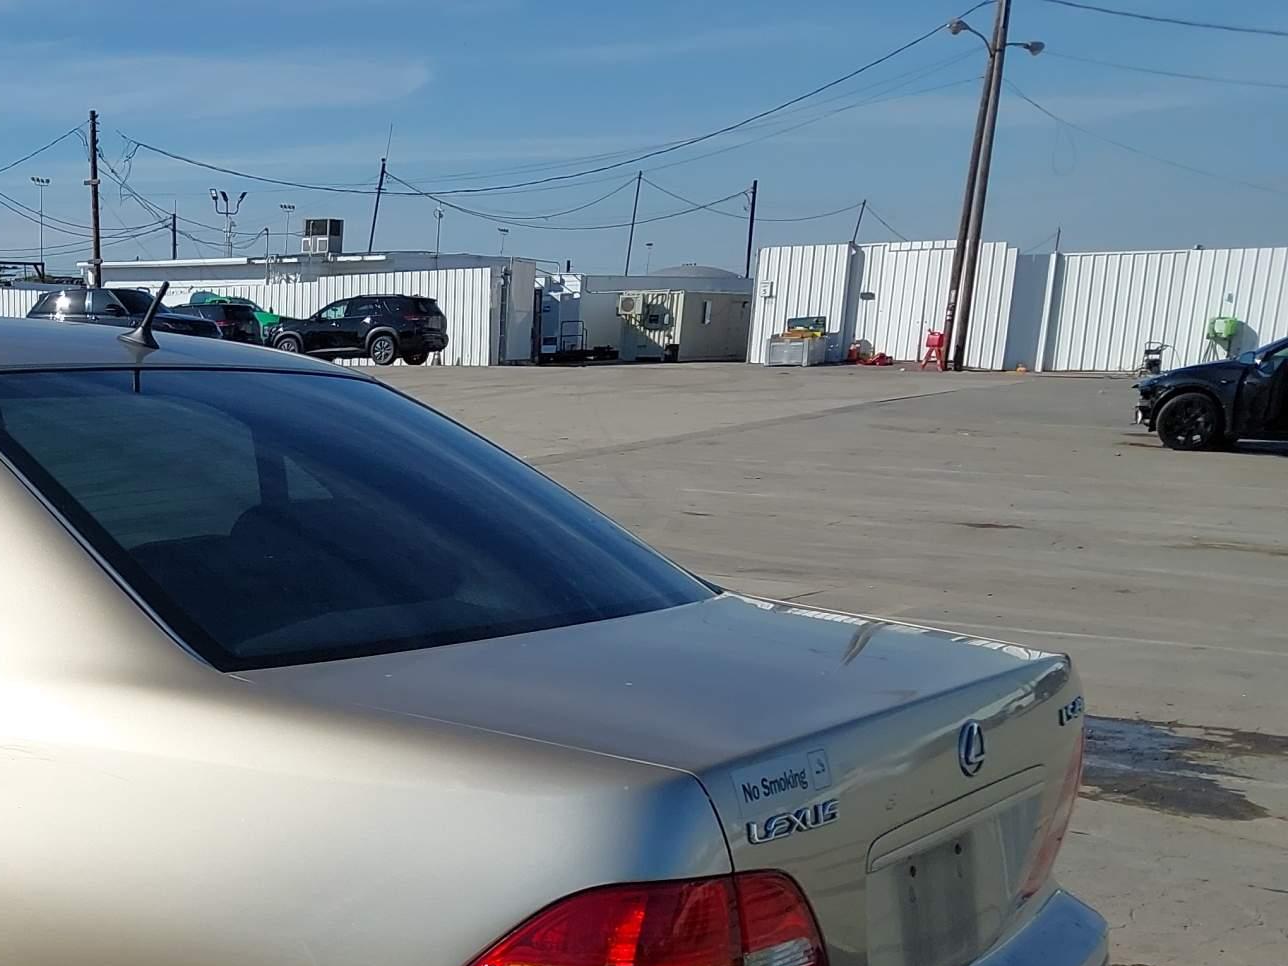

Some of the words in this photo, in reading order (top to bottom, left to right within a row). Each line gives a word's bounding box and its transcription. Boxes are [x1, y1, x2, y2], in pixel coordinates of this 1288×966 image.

[742, 782, 760, 803] No
[761, 768, 809, 797] Smoking
[746, 798, 840, 845] LEXUS
